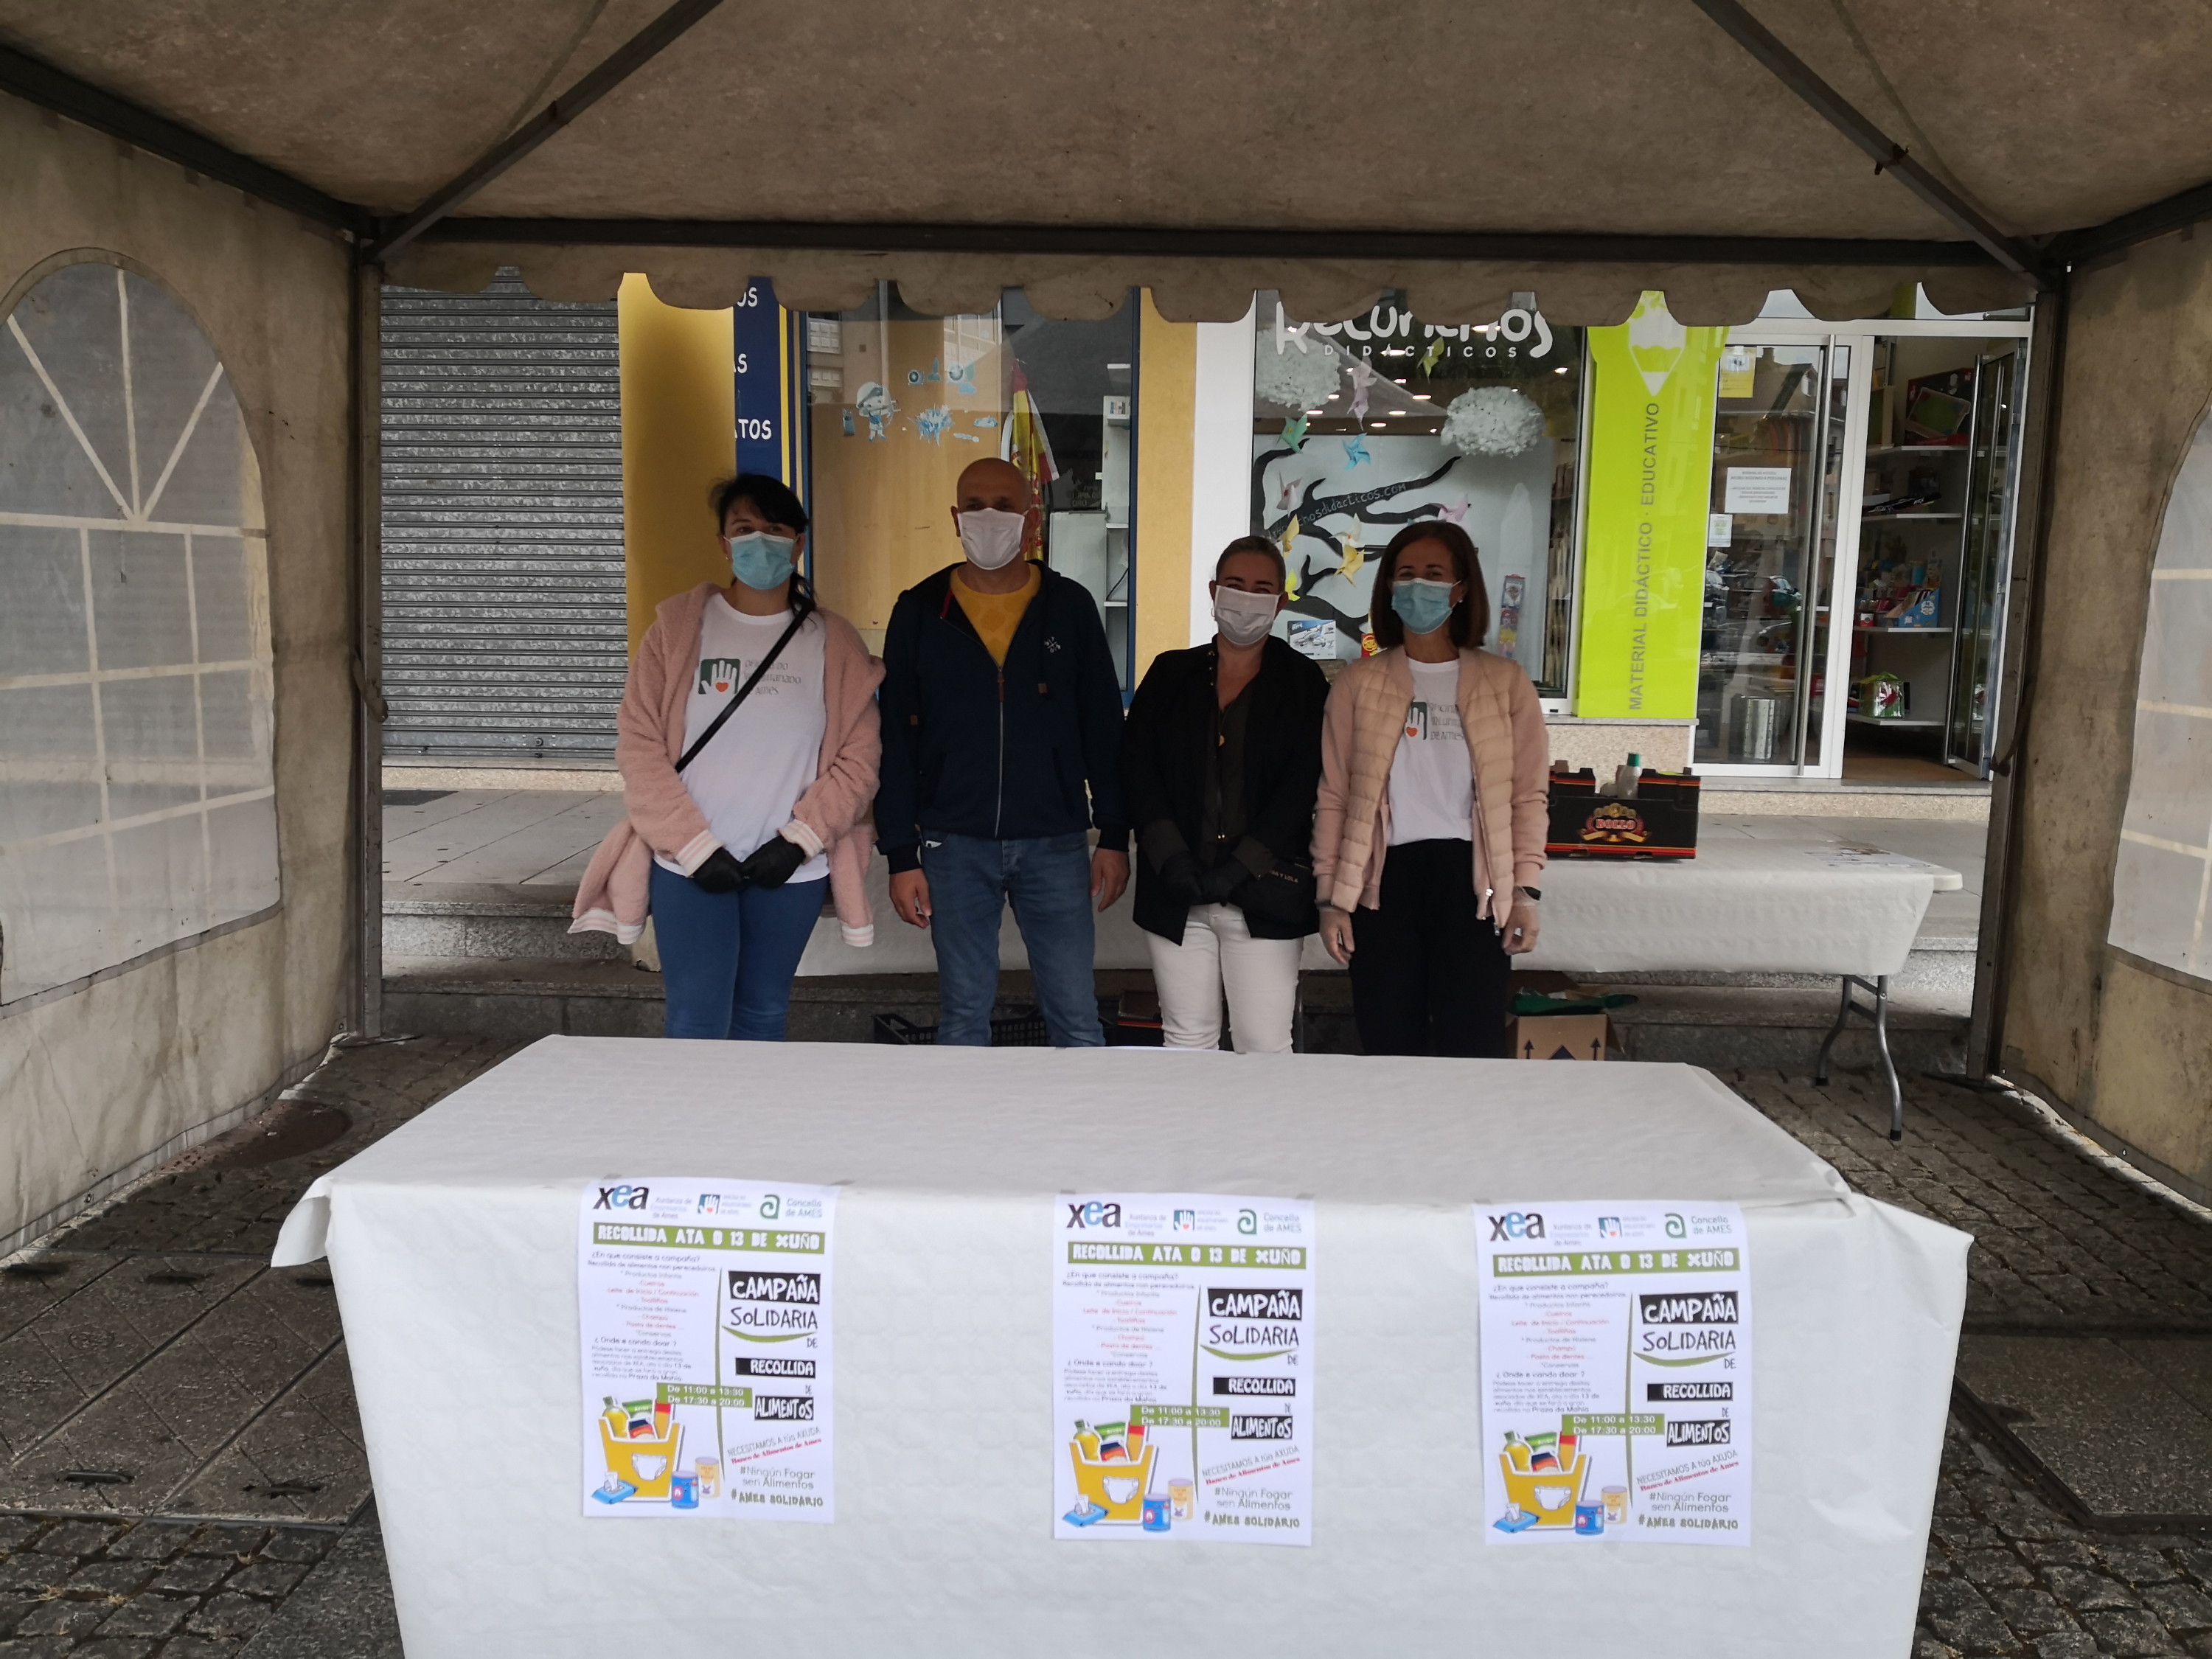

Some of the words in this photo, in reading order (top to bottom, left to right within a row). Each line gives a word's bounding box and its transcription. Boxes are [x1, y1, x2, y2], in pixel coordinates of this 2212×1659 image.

[735, 419, 772, 440] TOS
[1641, 402, 1660, 506] EDUCATIVO
[1632, 522, 1652, 616] DIDÁCTICO
[1630, 623, 1646, 710] MATERIAL
[593, 1185, 650, 1210] xea
[787, 1198, 821, 1207] Concello
[798, 1209, 822, 1217] AMES
[1066, 1201, 1121, 1228] xea
[1264, 1212, 1299, 1221] Concello
[1691, 1215, 1728, 1225] Concello
[1264, 1223, 1274, 1231] de
[1276, 1224, 1301, 1233] AMES
[1487, 1212, 1545, 1242] xea
[1694, 1226, 1704, 1234] de
[1706, 1225, 1732, 1234] AMES
[598, 1225, 667, 1243] RECOLLIDA
[675, 1229, 705, 1245] ATA
[730, 1231, 744, 1247] 13
[752, 1232, 767, 1247] DE
[776, 1233, 820, 1250] XUÑO
[1073, 1244, 1144, 1261] RECOLLIDA
[1152, 1246, 1182, 1262] ATA
[1209, 1247, 1222, 1263] 13
[1231, 1248, 1246, 1263] DE
[1256, 1248, 1301, 1265] XUÑO
[1498, 1255, 1572, 1273] RECOLLIDA
[1581, 1254, 1612, 1270] ATA
[1639, 1253, 1653, 1270] 13
[1661, 1251, 1677, 1268] DE
[1687, 1251, 1733, 1268] XUÑO
[733, 1274, 818, 1303] CAMPAÑA
[1212, 1290, 1300, 1318] CAMPAÑA
[1644, 1293, 1737, 1322] CAMPAÑA
[731, 1307, 818, 1329] SOLIDARIA
[807, 1338, 818, 1348] DE
[1209, 1325, 1299, 1346] SOLIDARIA
[1643, 1329, 1736, 1352] SOLIDARIA
[751, 1360, 814, 1375] RECOLLIDA
[1287, 1354, 1298, 1366] DE
[1724, 1358, 1736, 1368] DE
[667, 1385, 680, 1393] De
[684, 1385, 707, 1394] 11:00
[1228, 1378, 1293, 1394] RECOLLIDA
[1663, 1384, 1731, 1398] RECOLLIDA
[720, 1398, 744, 1406] 20:00
[756, 1397, 813, 1419] ALIMENTOS
[1158, 1407, 1183, 1415] 11:00
[1722, 1408, 1728, 1417] DE
[1232, 1416, 1292, 1439] ALIMENTOS
[1668, 1422, 1730, 1444] ALIMENTOS
[727, 1437, 776, 1457] NECESITAMOS
[797, 1426, 821, 1439] AXUDA
[1202, 1458, 1253, 1478] NECESITAMOS
[1275, 1445, 1299, 1458] AXUDA
[1637, 1464, 1690, 1485] NECESITAMOS
[1691, 1461, 1697, 1470] A
[1712, 1450, 1738, 1463] AXUDA
[785, 1468, 814, 1480] Fogar
[1674, 1470, 1708, 1484] Alimentos
[1719, 1461, 1739, 1470] Ames
[763, 1478, 814, 1489] Alimentos
[770, 1495, 823, 1507] SOLIDARIO
[1261, 1489, 1292, 1500] Fogar
[1649, 1492, 1694, 1502] #Ningún
[1697, 1493, 1731, 1503] Fogar
[1217, 1500, 1235, 1508] sen
[1238, 1499, 1290, 1511] Alimentos
[1674, 1502, 1728, 1512] Alimentos
[1245, 1517, 1300, 1528] SOLIDARIO
[1680, 1518, 1738, 1529] SOLIDARIO
